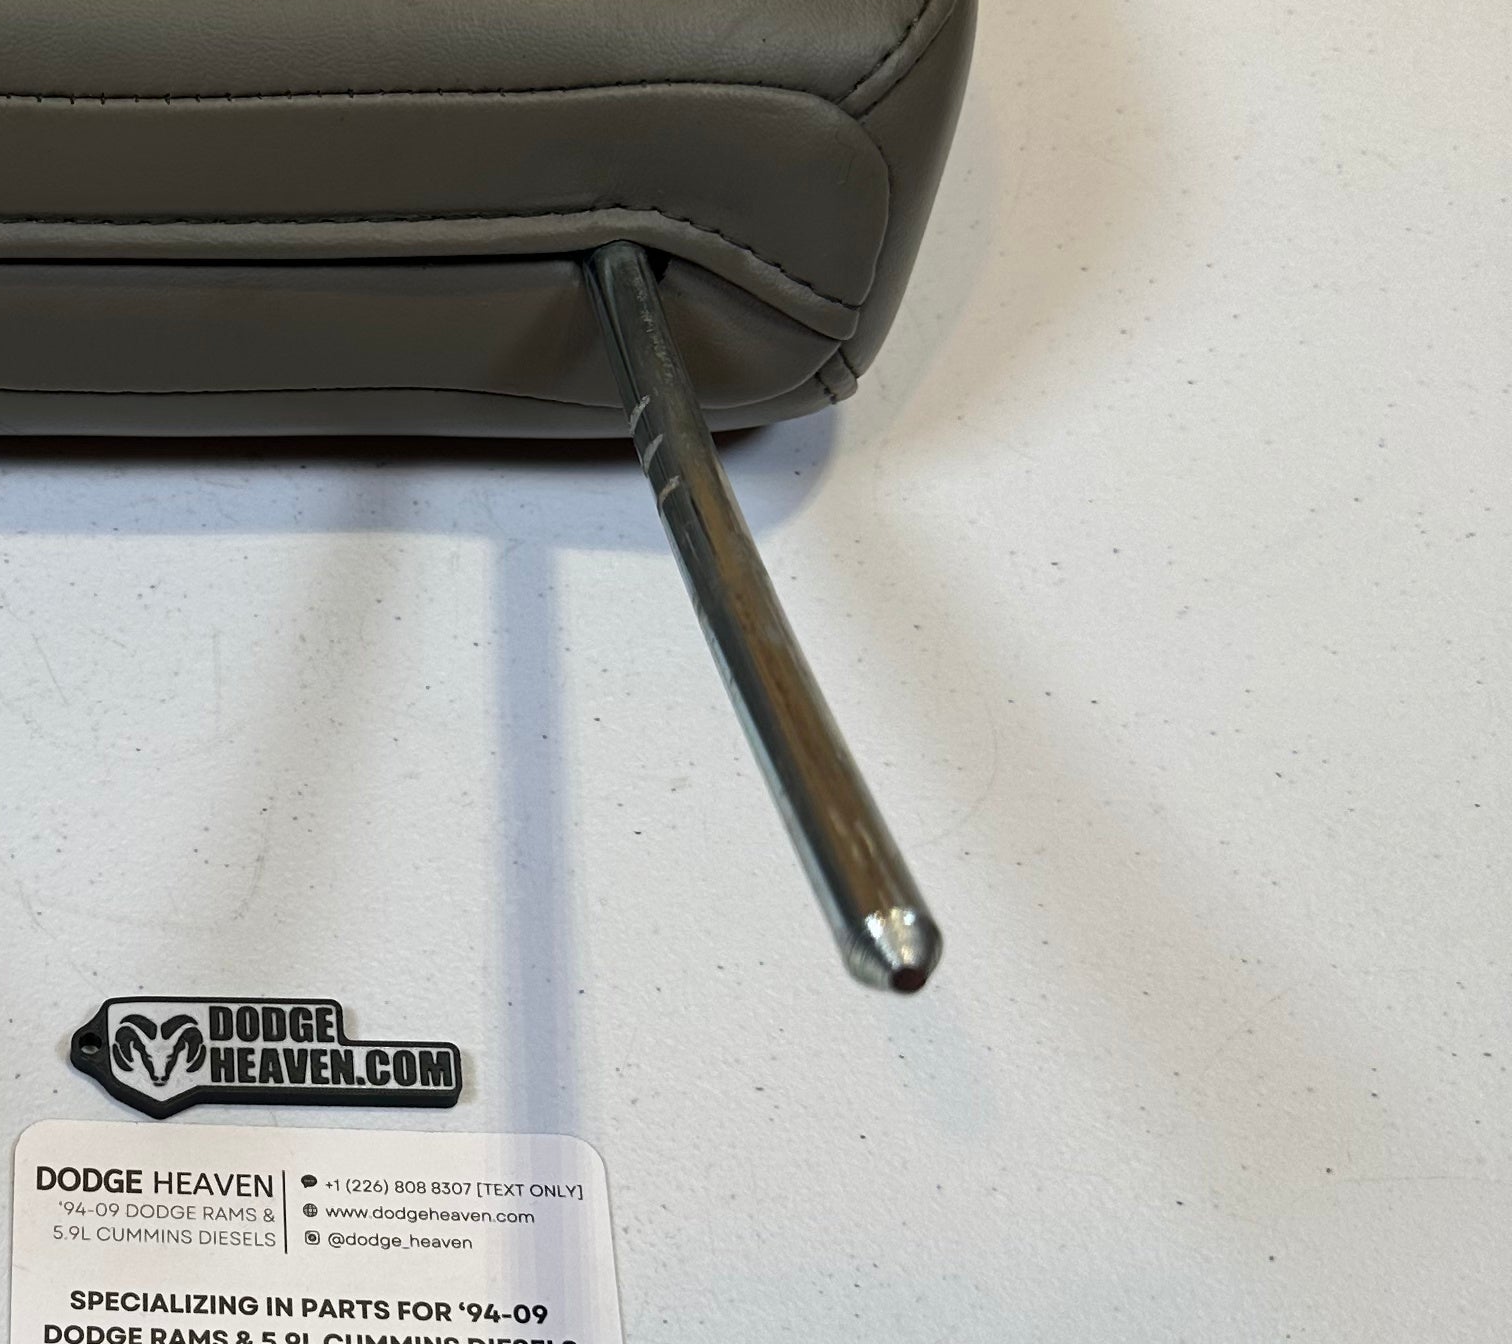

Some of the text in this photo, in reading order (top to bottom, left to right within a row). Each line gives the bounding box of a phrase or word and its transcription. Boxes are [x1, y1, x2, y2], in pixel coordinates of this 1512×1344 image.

[209, 1005, 334, 1042] DODGE
[210, 1049, 452, 1087] HEAVEN.COM
[37, 1166, 273, 1197] DODGE HEAVEN
[326, 1179, 583, 1200] +1 (226) 808 8307 [TEXT ONLY]
[127, 1204, 196, 1219] DODGE
[203, 1207, 256, 1221] RAMS
[263, 1208, 275, 1222] &
[326, 1206, 535, 1223] www.dodgeheaven.com
[54, 1225, 275, 1247] 5.9L CUMMINS DIESELS
[328, 1233, 472, 1250] @dodge_heaven
[71, 1290, 258, 1315] SPECIALIZING
[267, 1297, 293, 1317] IN
[302, 1298, 390, 1319] PARTS
[398, 1301, 452, 1321] FOR
